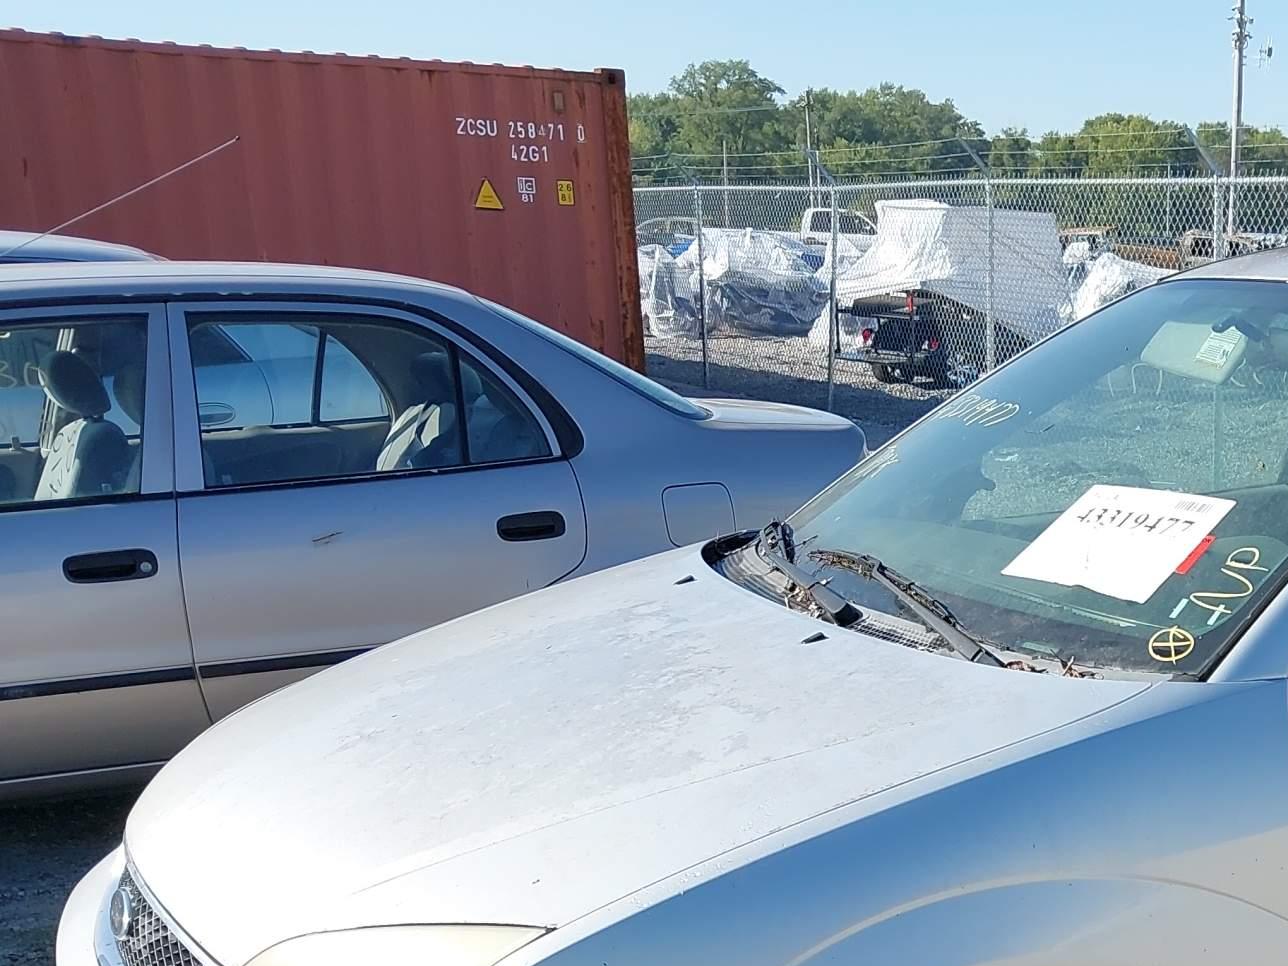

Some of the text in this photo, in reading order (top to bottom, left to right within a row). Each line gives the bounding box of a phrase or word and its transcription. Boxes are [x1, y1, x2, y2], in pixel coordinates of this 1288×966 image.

[456, 117, 498, 136] ZCSU
[508, 121, 564, 141] 258471
[511, 144, 548, 162] 42G1
[1077, 507, 1196, 534] 43319477
